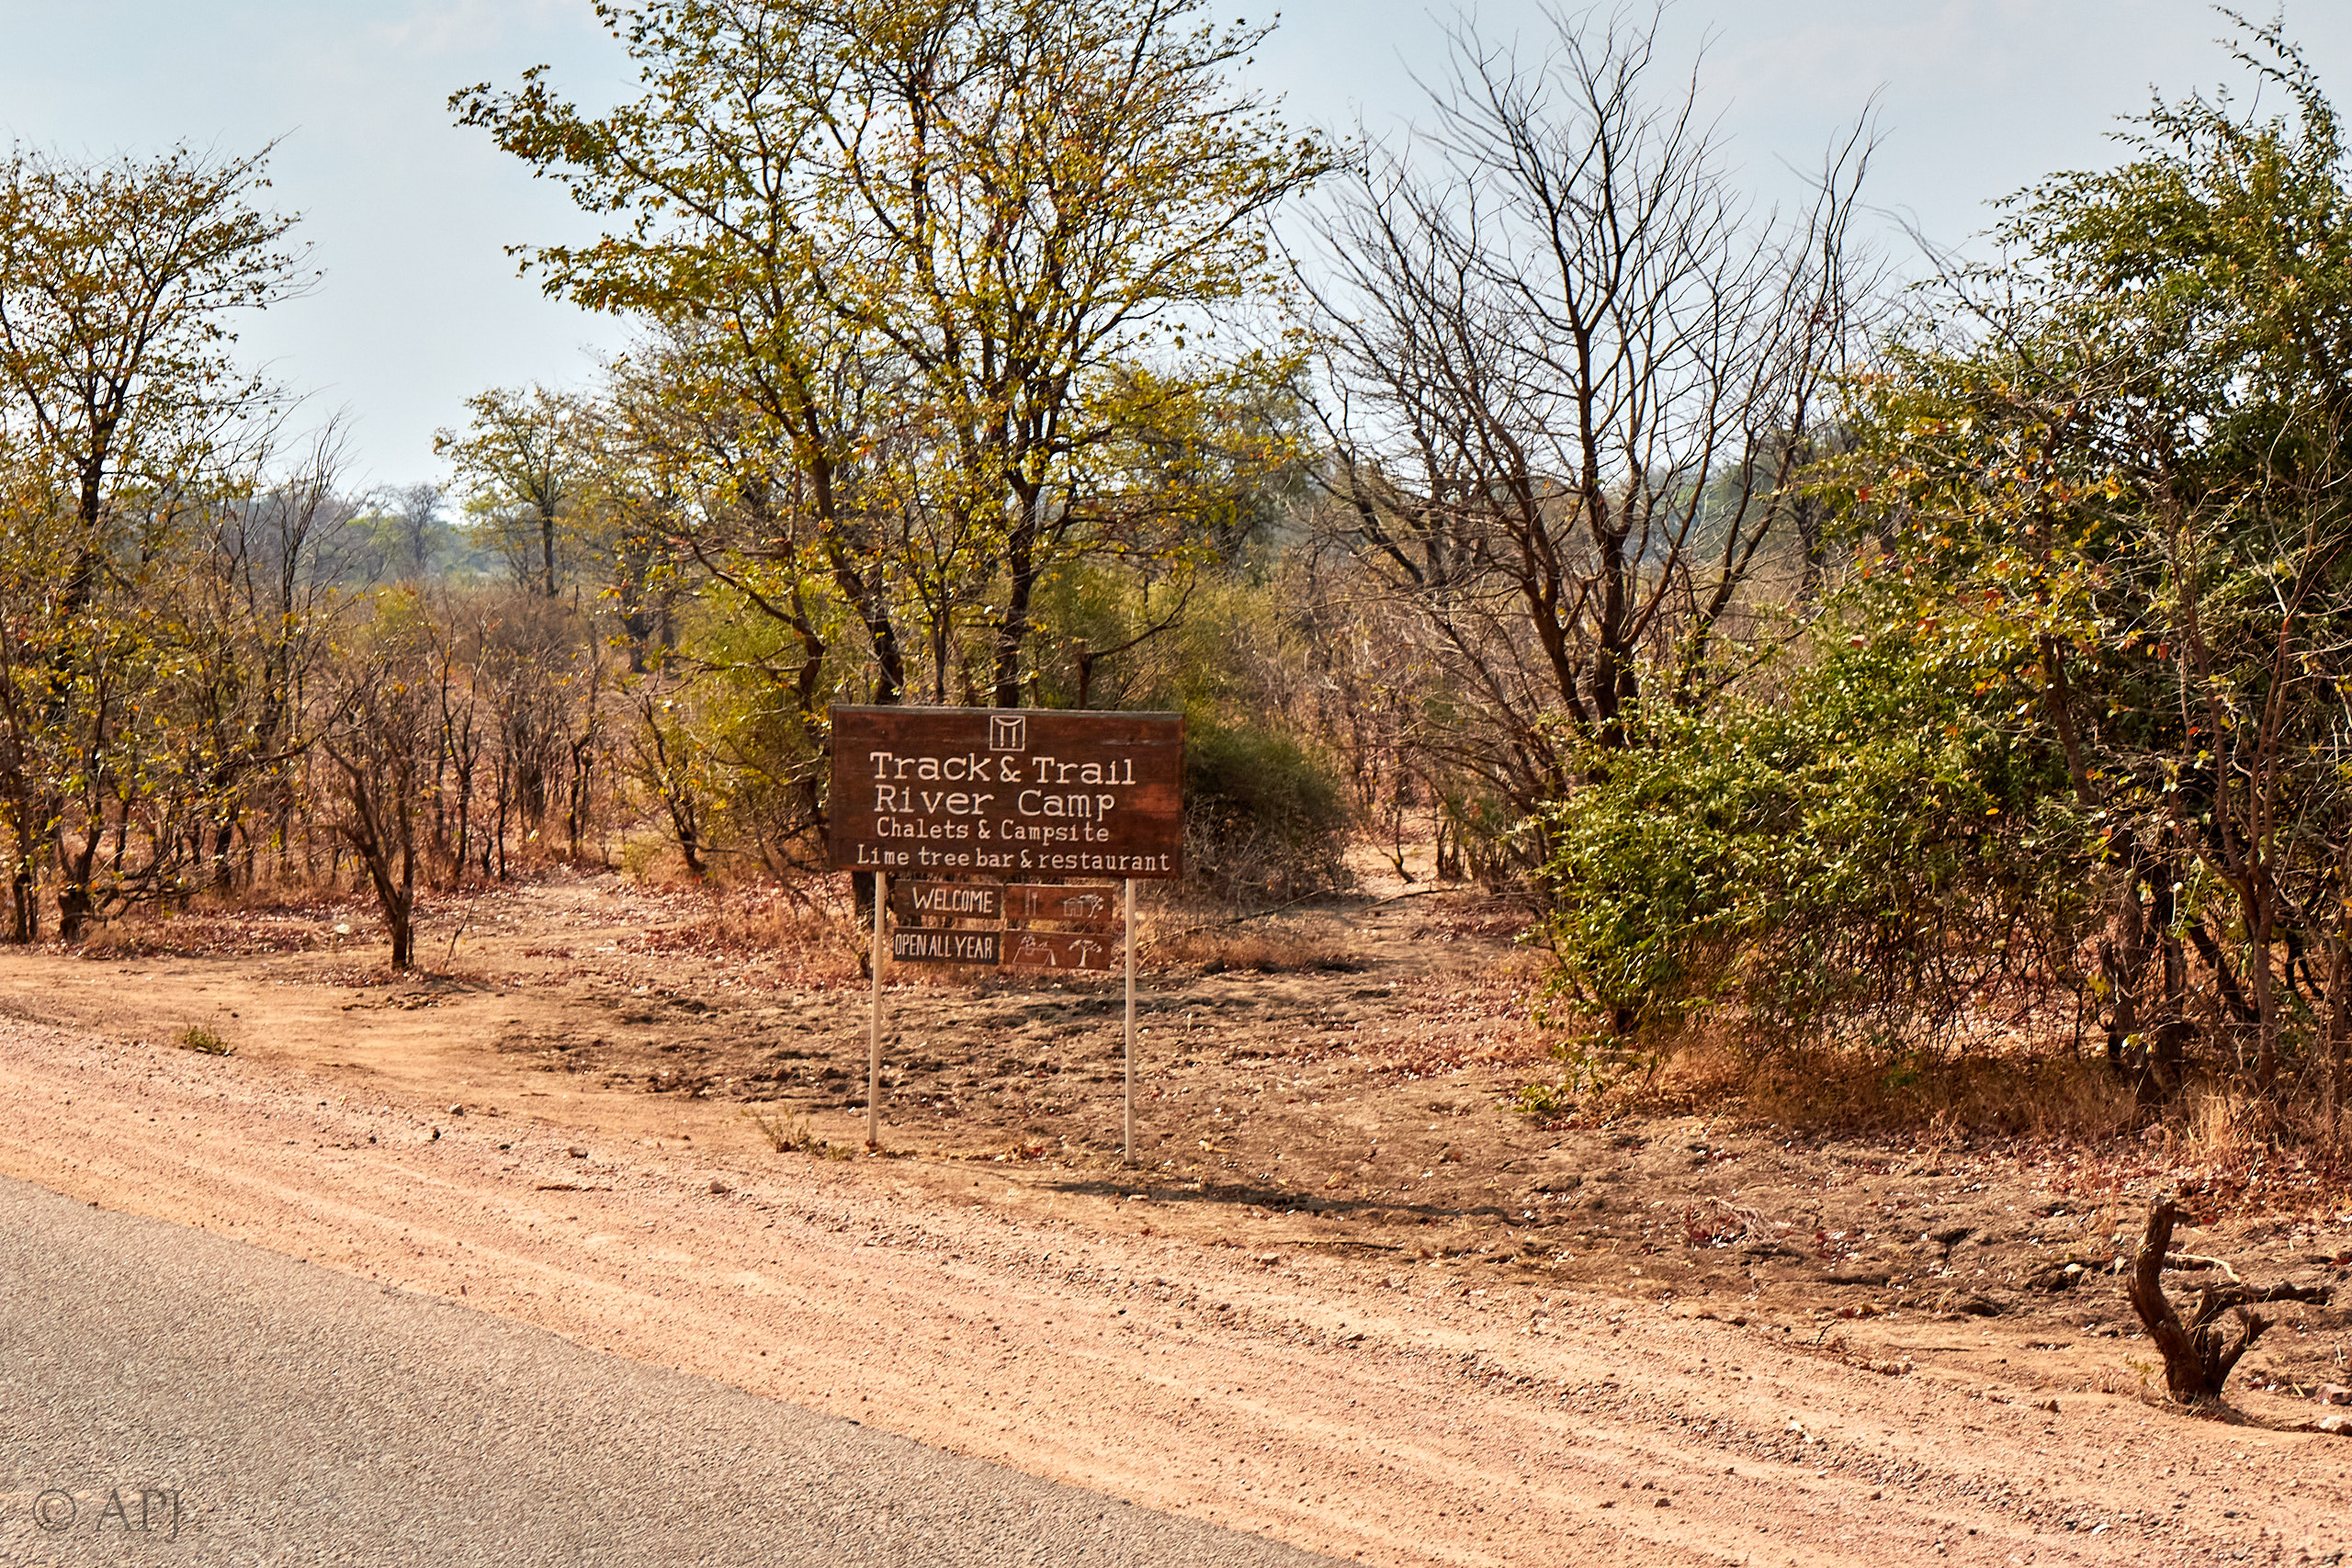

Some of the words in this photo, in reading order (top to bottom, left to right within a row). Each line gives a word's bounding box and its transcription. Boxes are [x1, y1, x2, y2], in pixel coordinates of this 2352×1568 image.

[869, 751, 991, 782] Track
[1000, 756, 1022, 783] &
[1032, 756, 1136, 785] Trail
[874, 784, 994, 816] River
[1018, 788, 1115, 822] Camp
[876, 816, 968, 840] Chalets
[978, 819, 991, 840] &
[1001, 820, 1110, 846] Campsite
[857, 843, 909, 866] Lime
[919, 847, 970, 867] tree
[976, 848, 1013, 868] bar
[1021, 849, 1032, 869] &
[1038, 851, 1170, 872] restaurant
[912, 887, 992, 913] WELCOME
[895, 933, 927, 956] OPEN
[928, 934, 952, 958] ALL
[955, 936, 992, 959] YEAR
